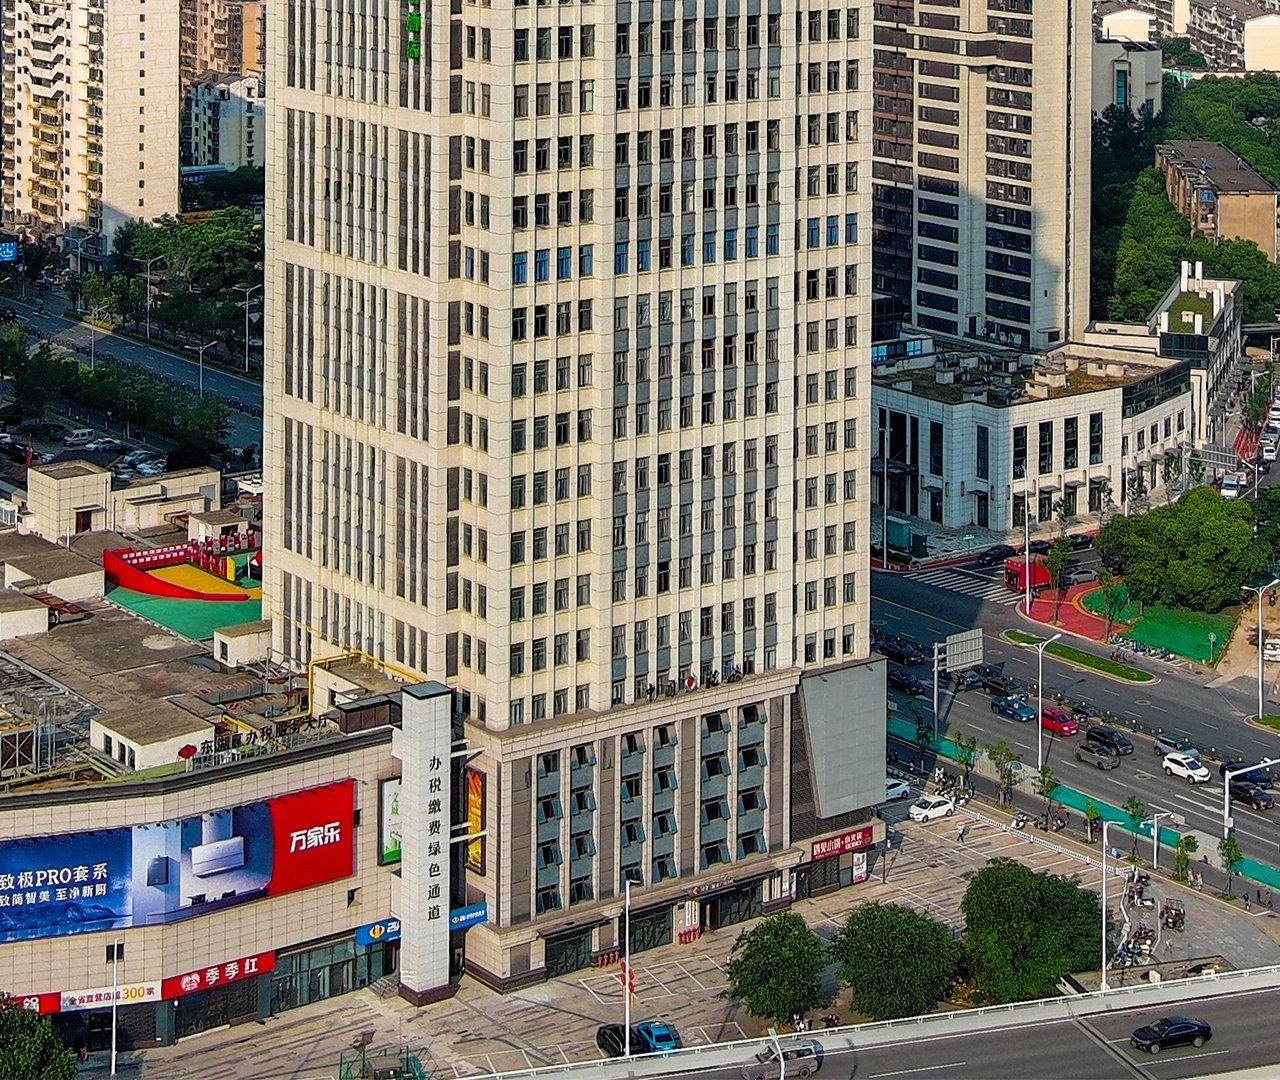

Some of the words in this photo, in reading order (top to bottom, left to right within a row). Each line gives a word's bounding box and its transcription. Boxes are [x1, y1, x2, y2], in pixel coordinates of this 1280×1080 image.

[290, 821, 341, 853] 万家乐
[427, 756, 442, 922] 办税缴费绿色通道
[55, 883, 107, 901] 至净新厨
[206, 957, 258, 985] 季季红
